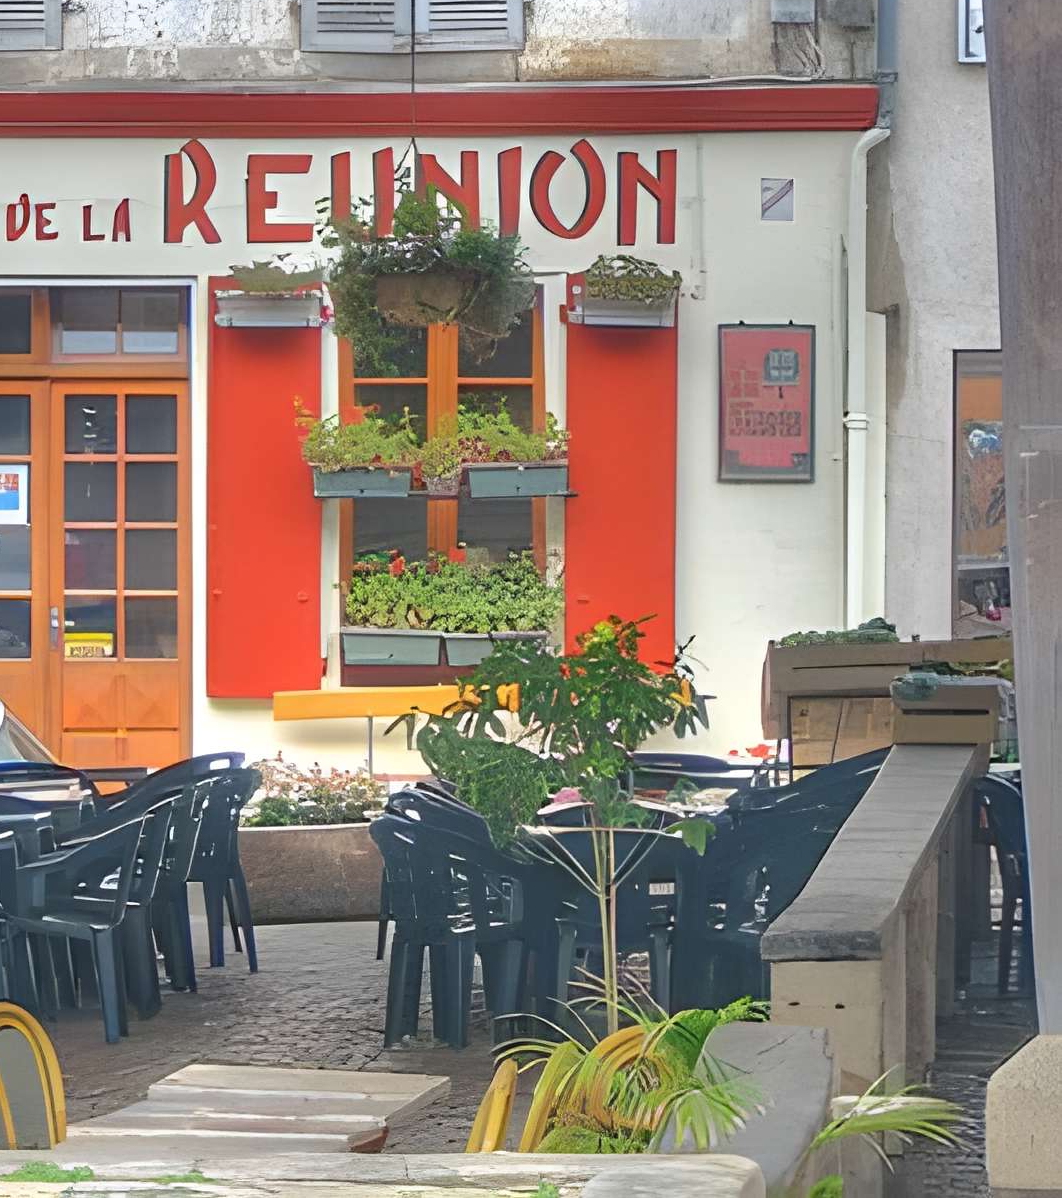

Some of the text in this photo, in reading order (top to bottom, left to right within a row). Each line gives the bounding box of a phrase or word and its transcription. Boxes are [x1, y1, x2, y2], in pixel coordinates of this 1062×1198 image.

[6, 193, 59, 242] DE
[83, 198, 132, 242] LA
[164, 139, 677, 246] REUNION
